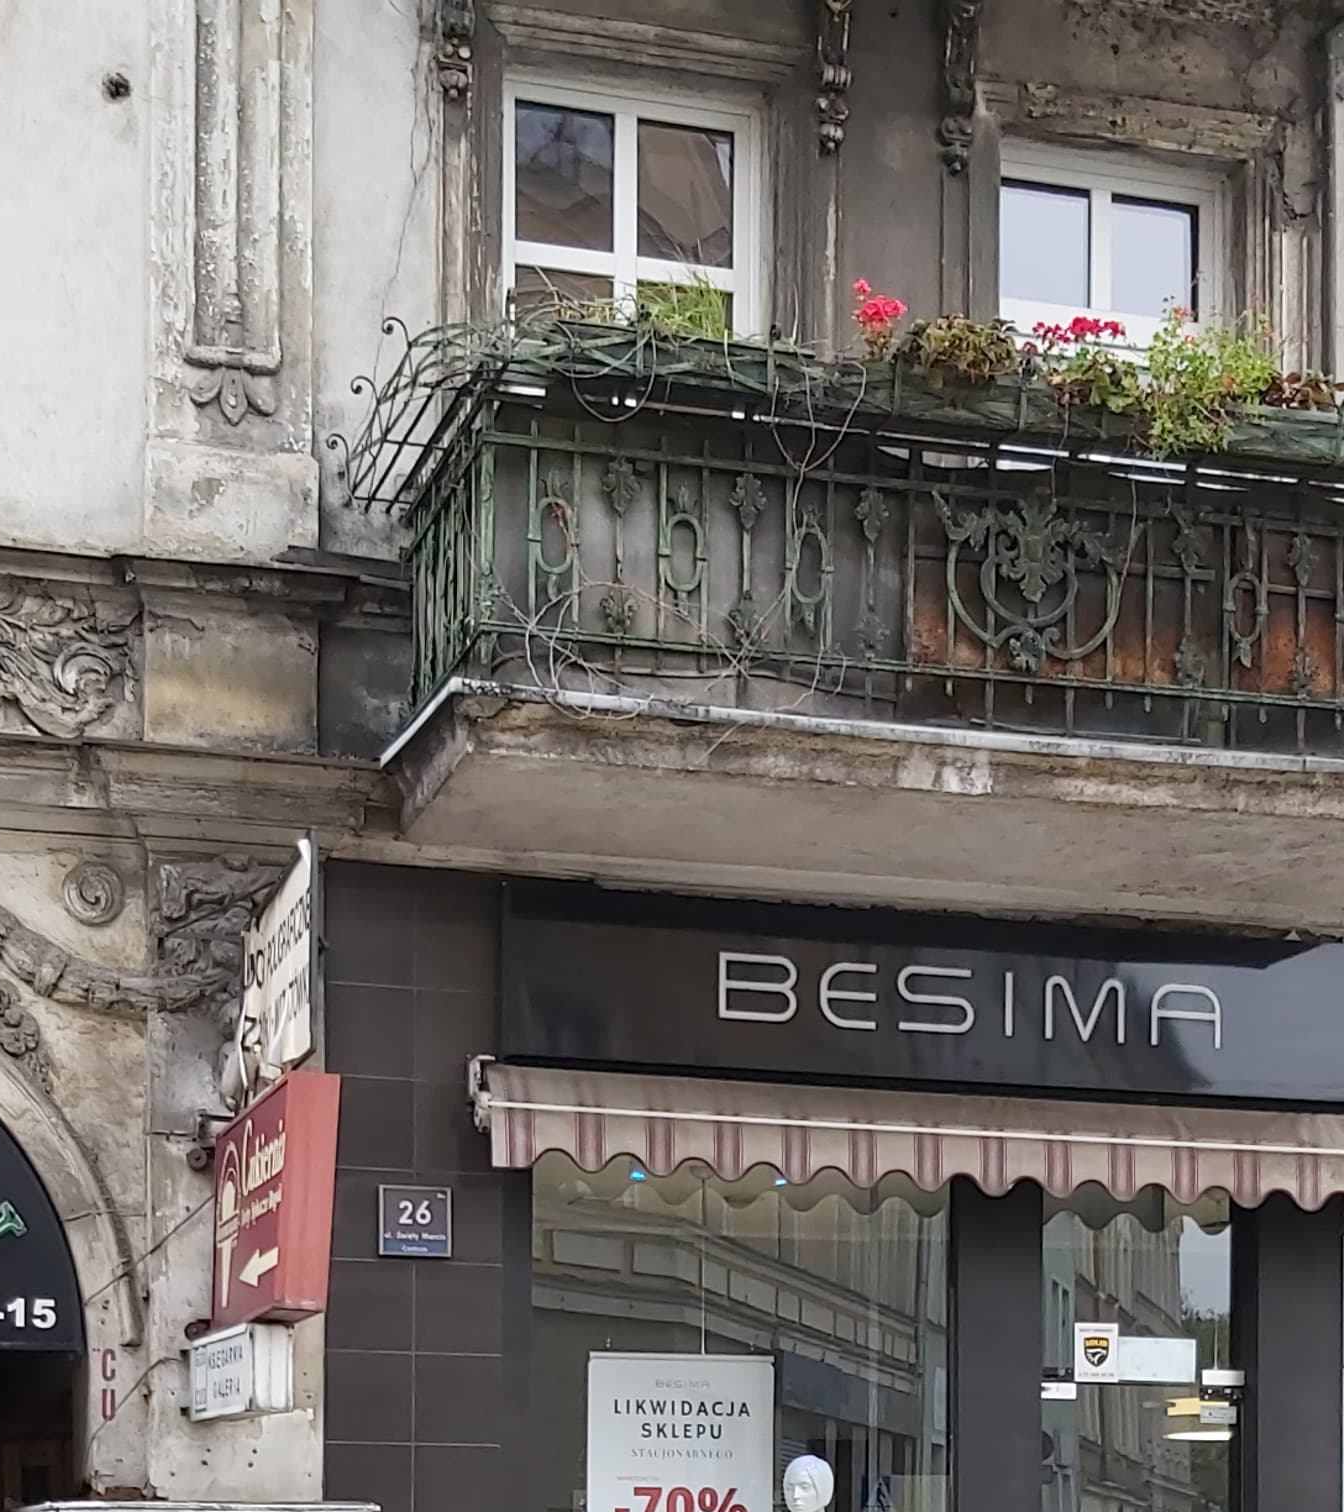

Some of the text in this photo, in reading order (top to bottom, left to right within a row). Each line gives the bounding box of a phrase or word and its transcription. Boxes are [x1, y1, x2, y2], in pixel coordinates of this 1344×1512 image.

[718, 951, 1222, 1049] BESIMA
[399, 1199, 432, 1225] 26
[613, 1399, 751, 1418] LIKWIDACJA
[640, 1422, 723, 1440] SKLEPU
